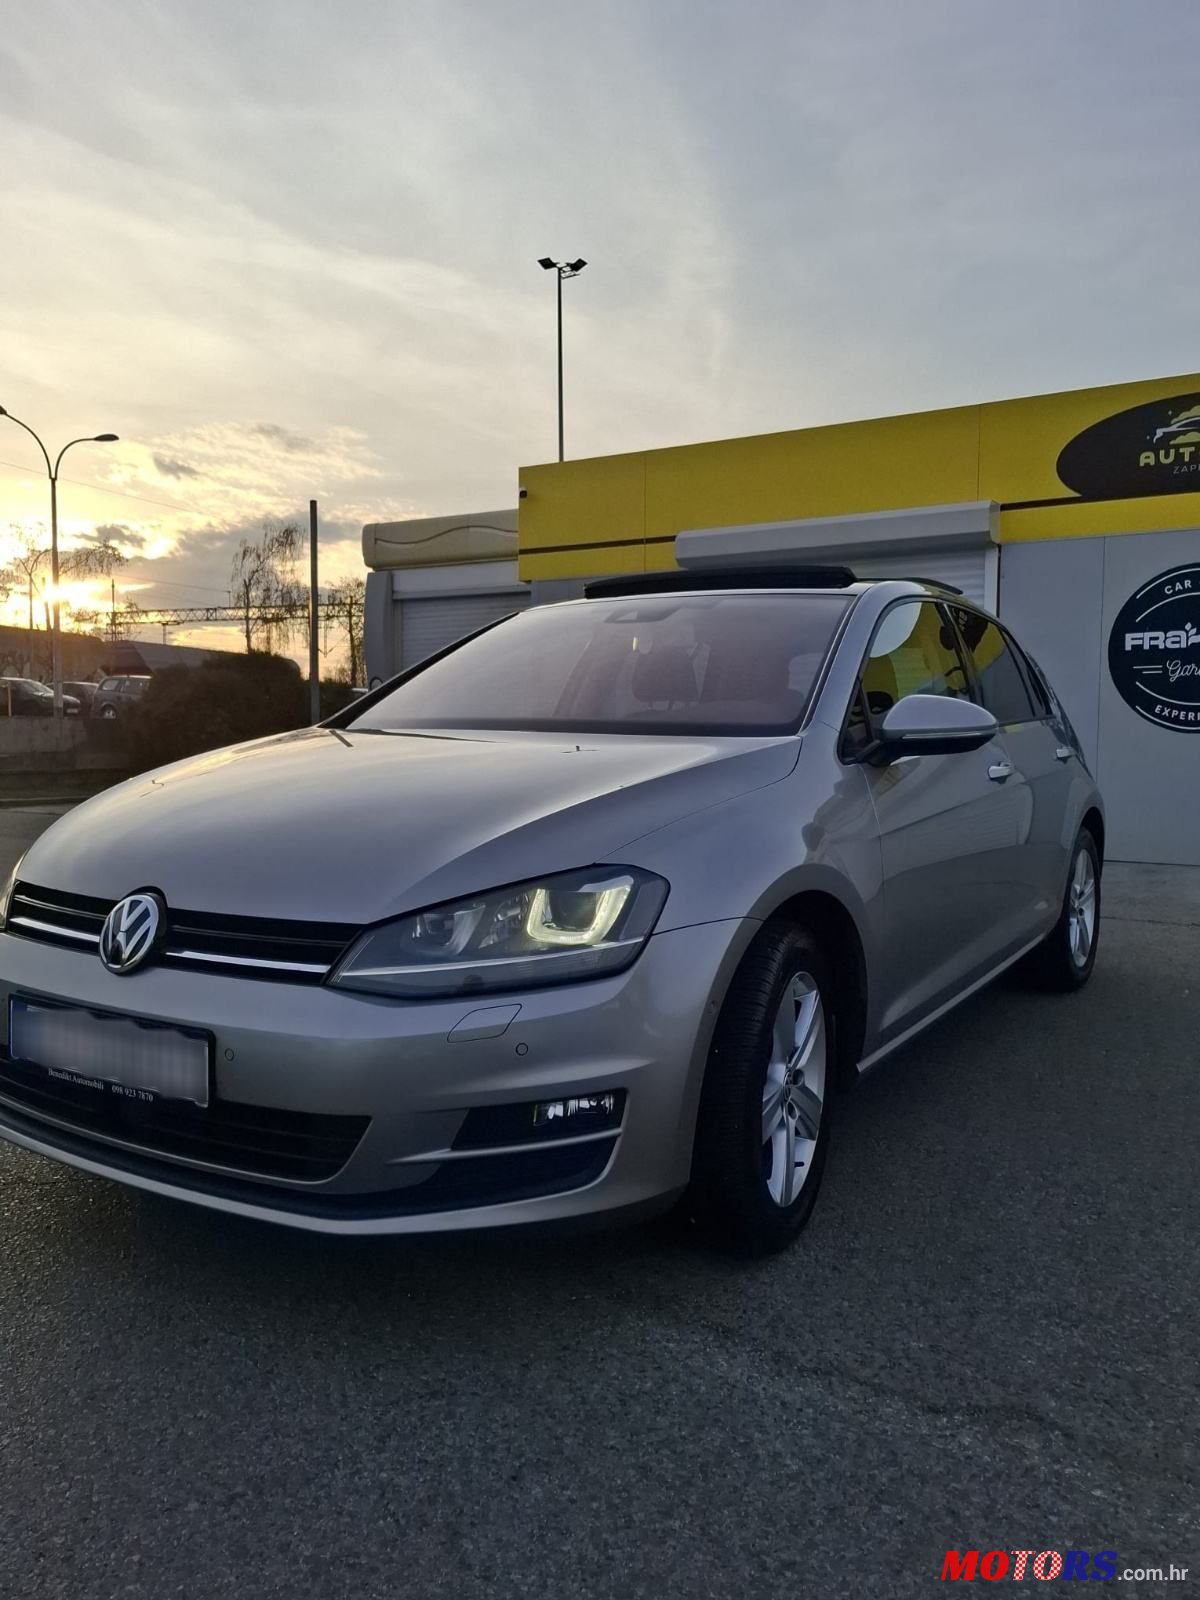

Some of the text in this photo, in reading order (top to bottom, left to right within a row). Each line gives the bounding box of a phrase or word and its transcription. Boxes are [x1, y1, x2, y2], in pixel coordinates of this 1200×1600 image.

[1139, 447, 1200, 467] AUT
[1173, 464, 1200, 474] ZAP
[1164, 579, 1192, 594] CAR
[1166, 660, 1200, 682] Gar
